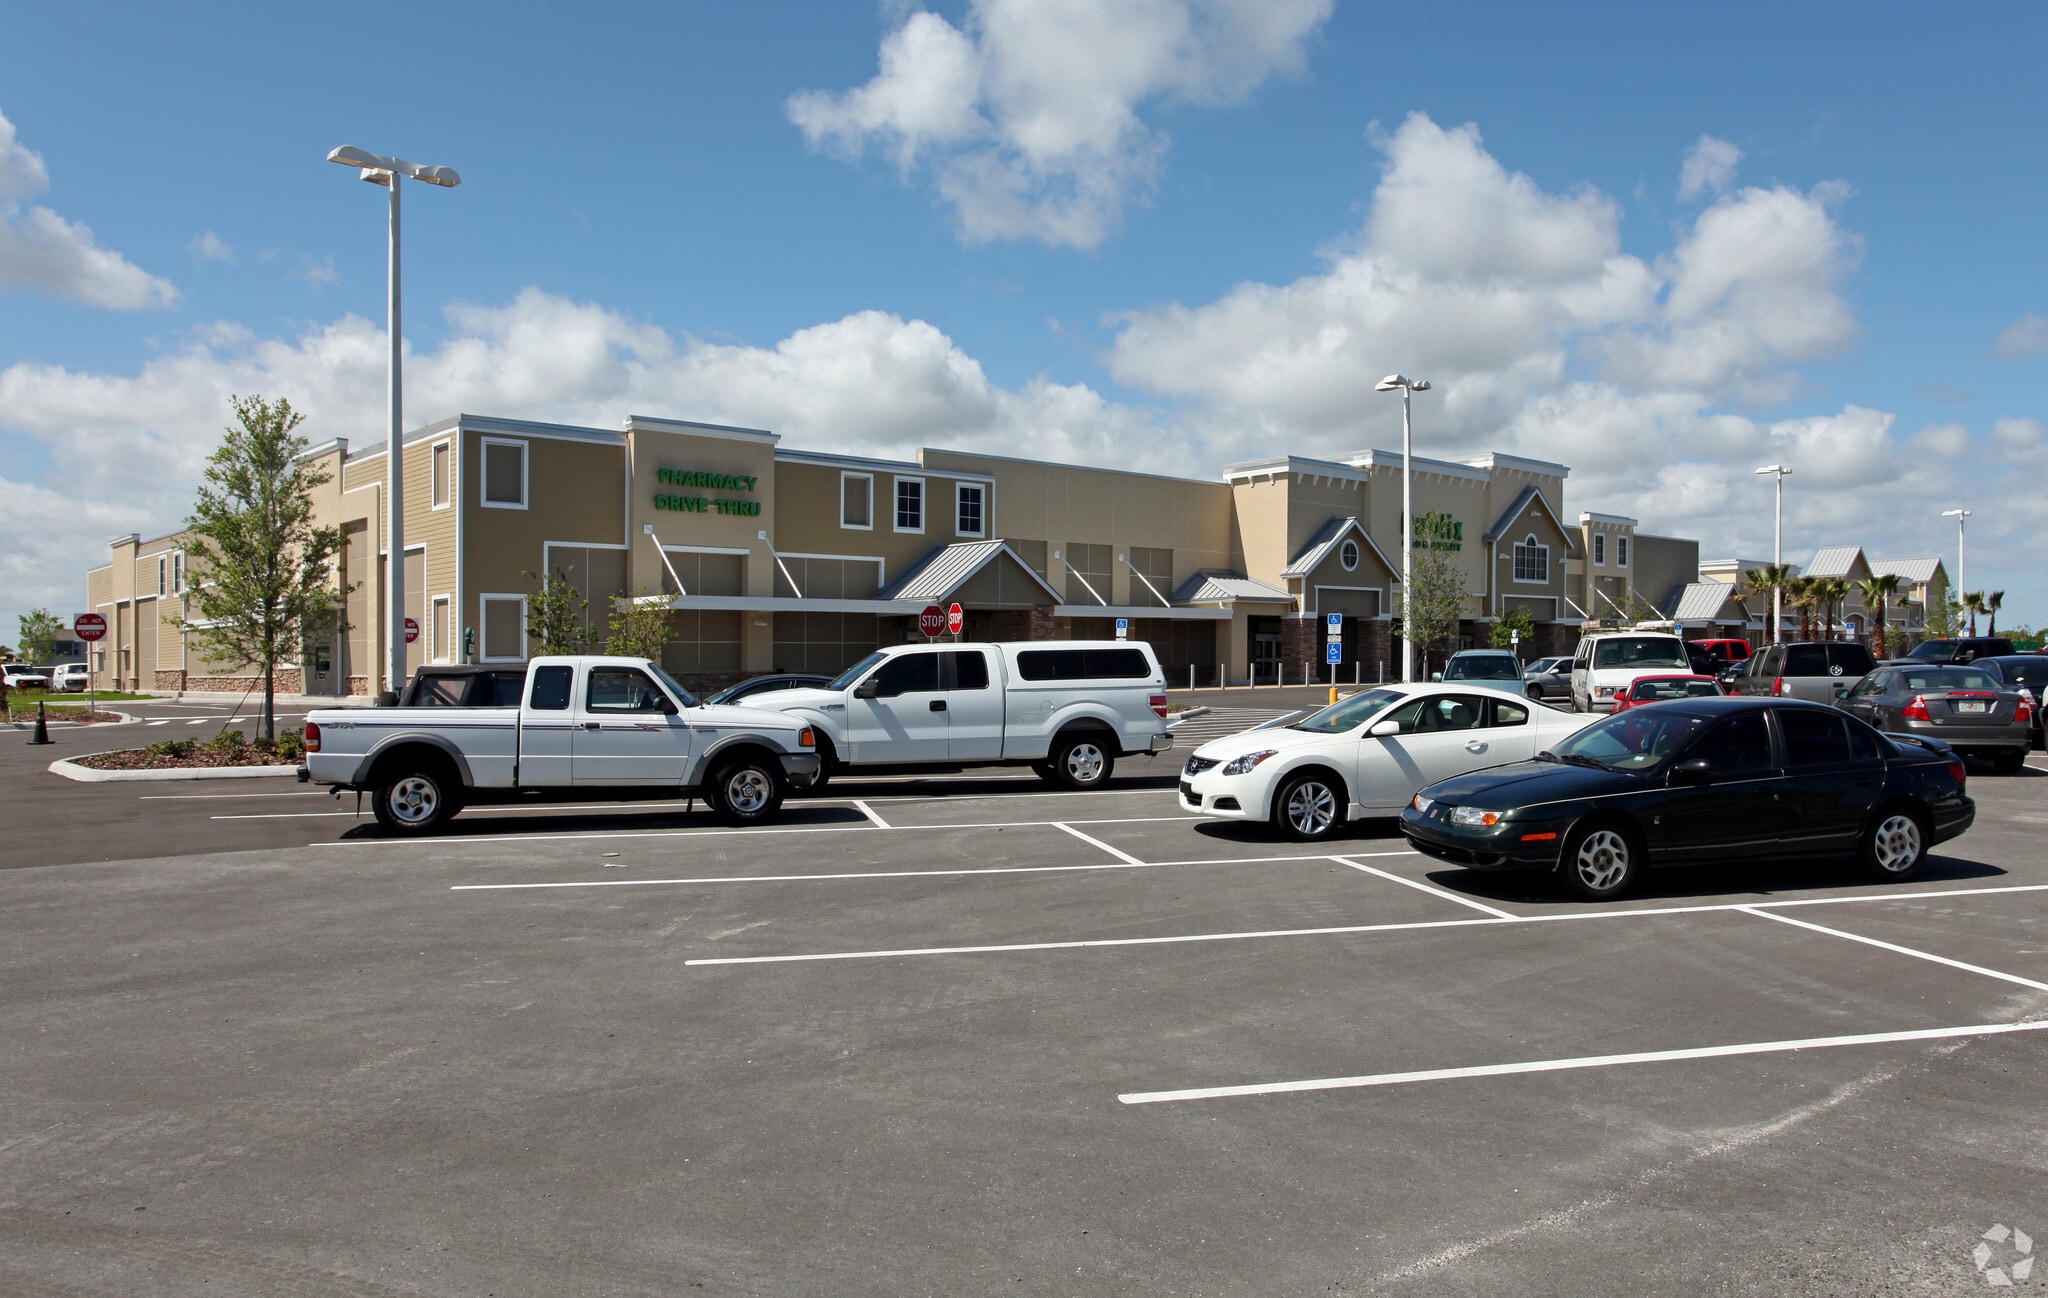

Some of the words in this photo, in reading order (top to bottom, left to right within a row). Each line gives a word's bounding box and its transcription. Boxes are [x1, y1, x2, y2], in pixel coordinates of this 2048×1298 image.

[657, 468, 758, 492] PHARMACY
[655, 494, 709, 513] DRIVE
[715, 499, 761, 517] THRU
[921, 615, 945, 627] STOP
[949, 612, 962, 625] STOP
